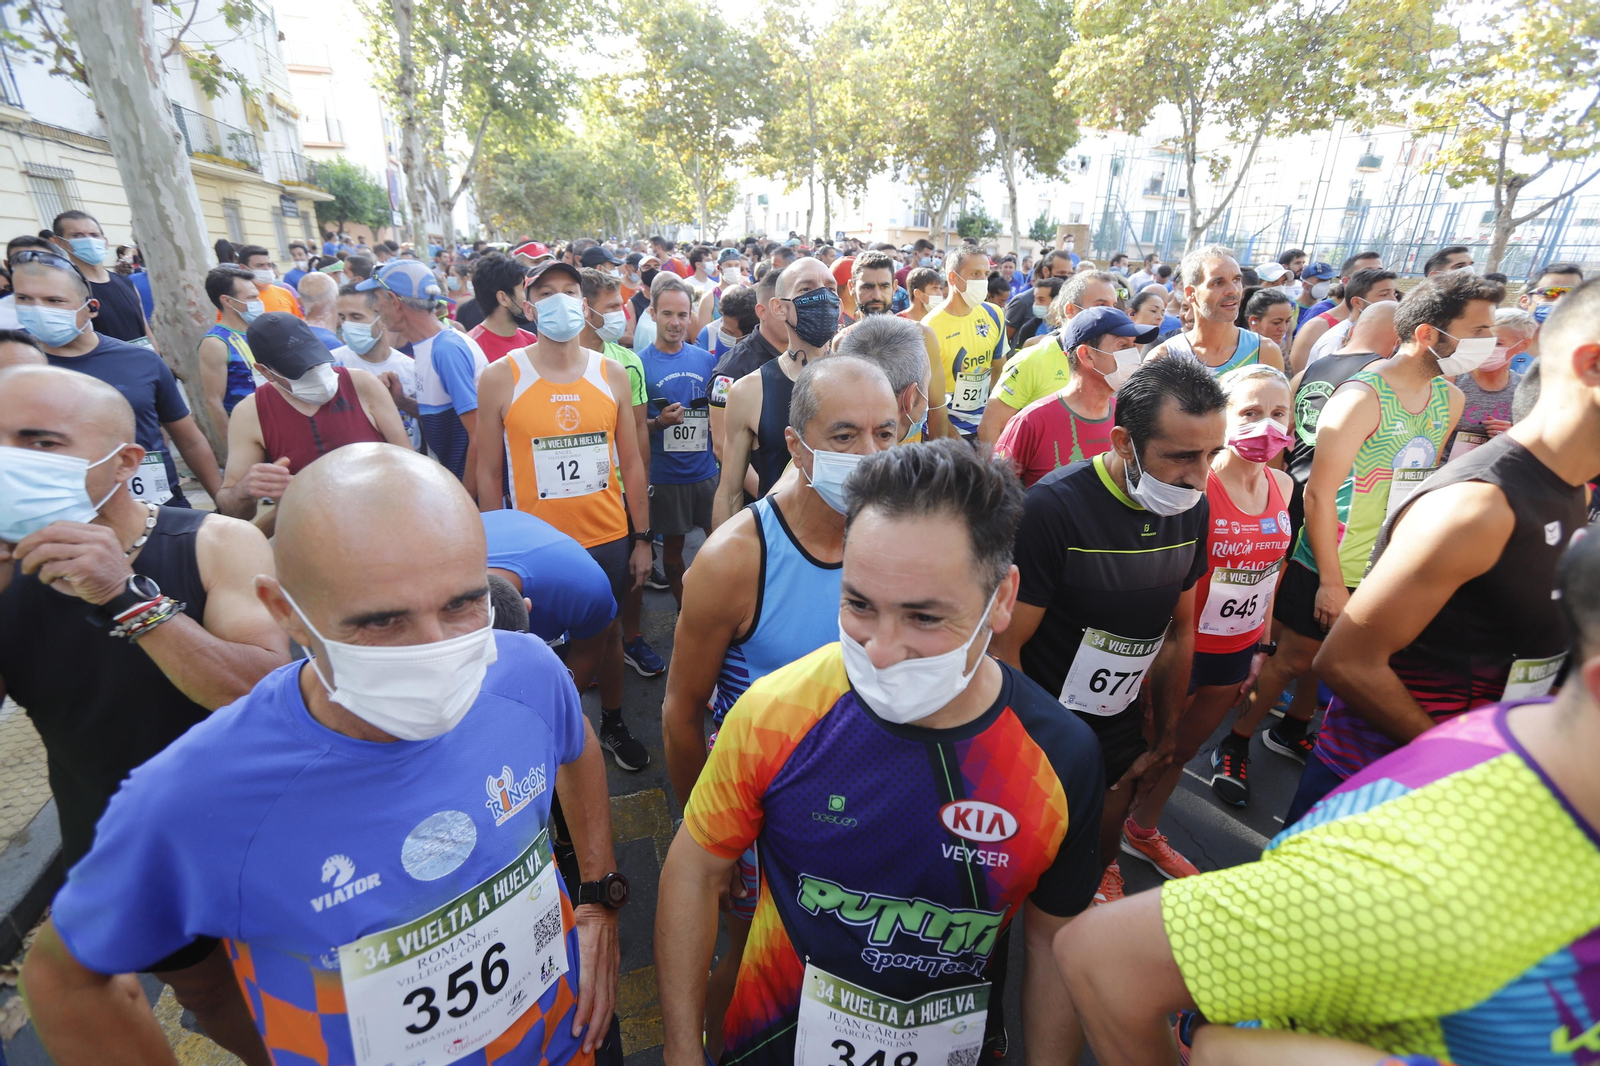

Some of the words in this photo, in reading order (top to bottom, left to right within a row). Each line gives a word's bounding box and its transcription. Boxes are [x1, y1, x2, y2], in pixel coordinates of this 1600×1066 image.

[963, 350, 991, 370] Snell
[963, 388, 982, 401] 521
[547, 438, 573, 448] VUELTA
[573, 437, 579, 446] A
[579, 435, 603, 446] HUELVA
[673, 426, 697, 440] 607
[556, 460, 580, 481] 12
[1216, 572, 1227, 582] 34
[1230, 572, 1260, 584] VUELTA
[1219, 594, 1258, 619] 645
[1092, 634, 1106, 648] 34
[1108, 639, 1144, 655] VUELTA
[1089, 668, 1144, 696] 677
[952, 806, 1007, 837] KIA
[942, 843, 1009, 868] VEYSER
[310, 872, 382, 913] VIATOR
[363, 942, 392, 971] 34
[397, 902, 474, 957] VUELTA
[478, 891, 490, 916] A
[493, 849, 543, 905] HUELVA
[396, 954, 458, 987] VILLEGAS
[459, 927, 499, 958] CORTES
[417, 928, 477, 970] ROMAN
[402, 942, 510, 1035] 356
[816, 979, 835, 1003] 34
[840, 988, 899, 1026] VUELTA
[904, 1009, 915, 1026] A
[920, 993, 976, 1023] HUELVA
[458, 1019, 471, 1030] EL
[827, 1011, 861, 1029] JUAN
[865, 1023, 919, 1040] CARLOS
[834, 1025, 872, 1041] GARCÍA
[873, 1036, 913, 1048] MOLINA
